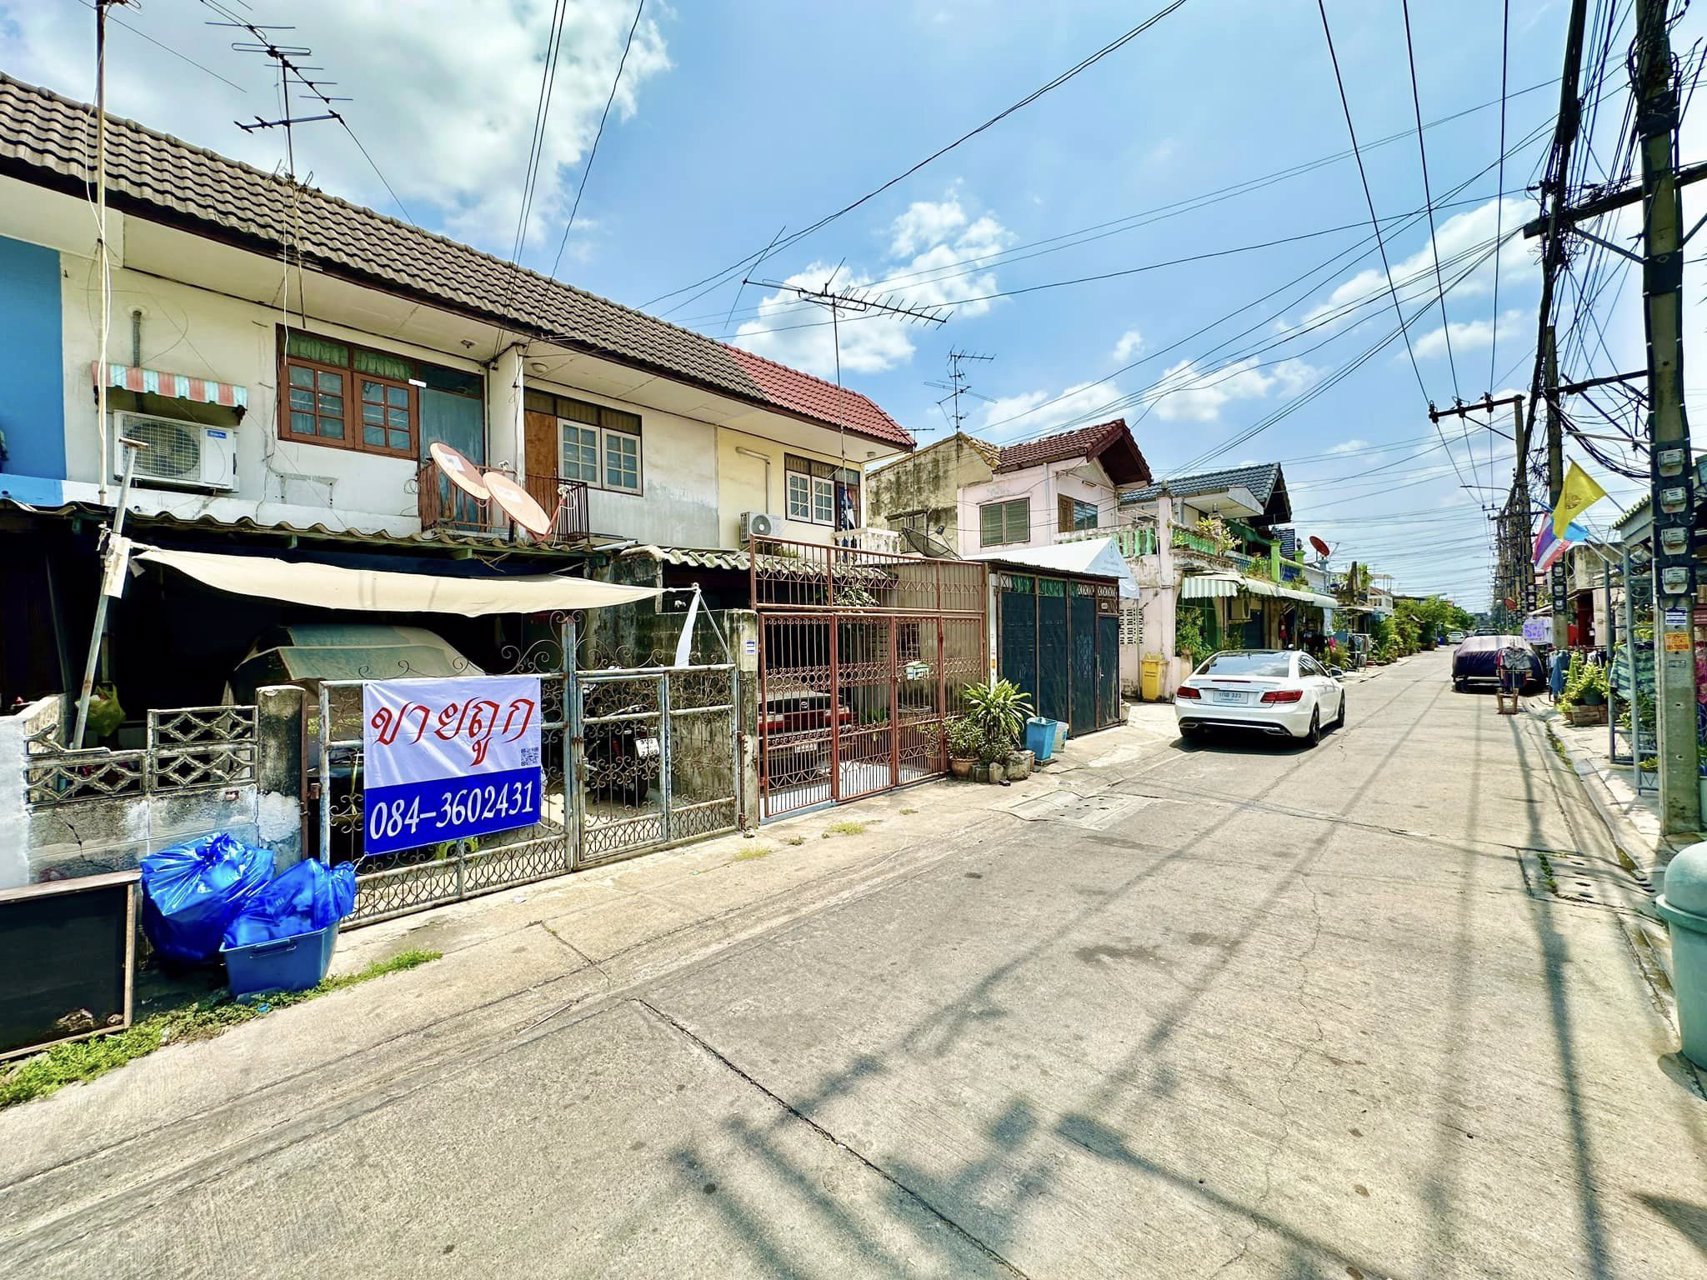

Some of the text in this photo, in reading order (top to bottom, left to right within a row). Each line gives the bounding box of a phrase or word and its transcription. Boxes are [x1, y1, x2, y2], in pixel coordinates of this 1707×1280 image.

[371, 696, 535, 766] ขายถูก
[369, 780, 534, 840] 084-3602431
